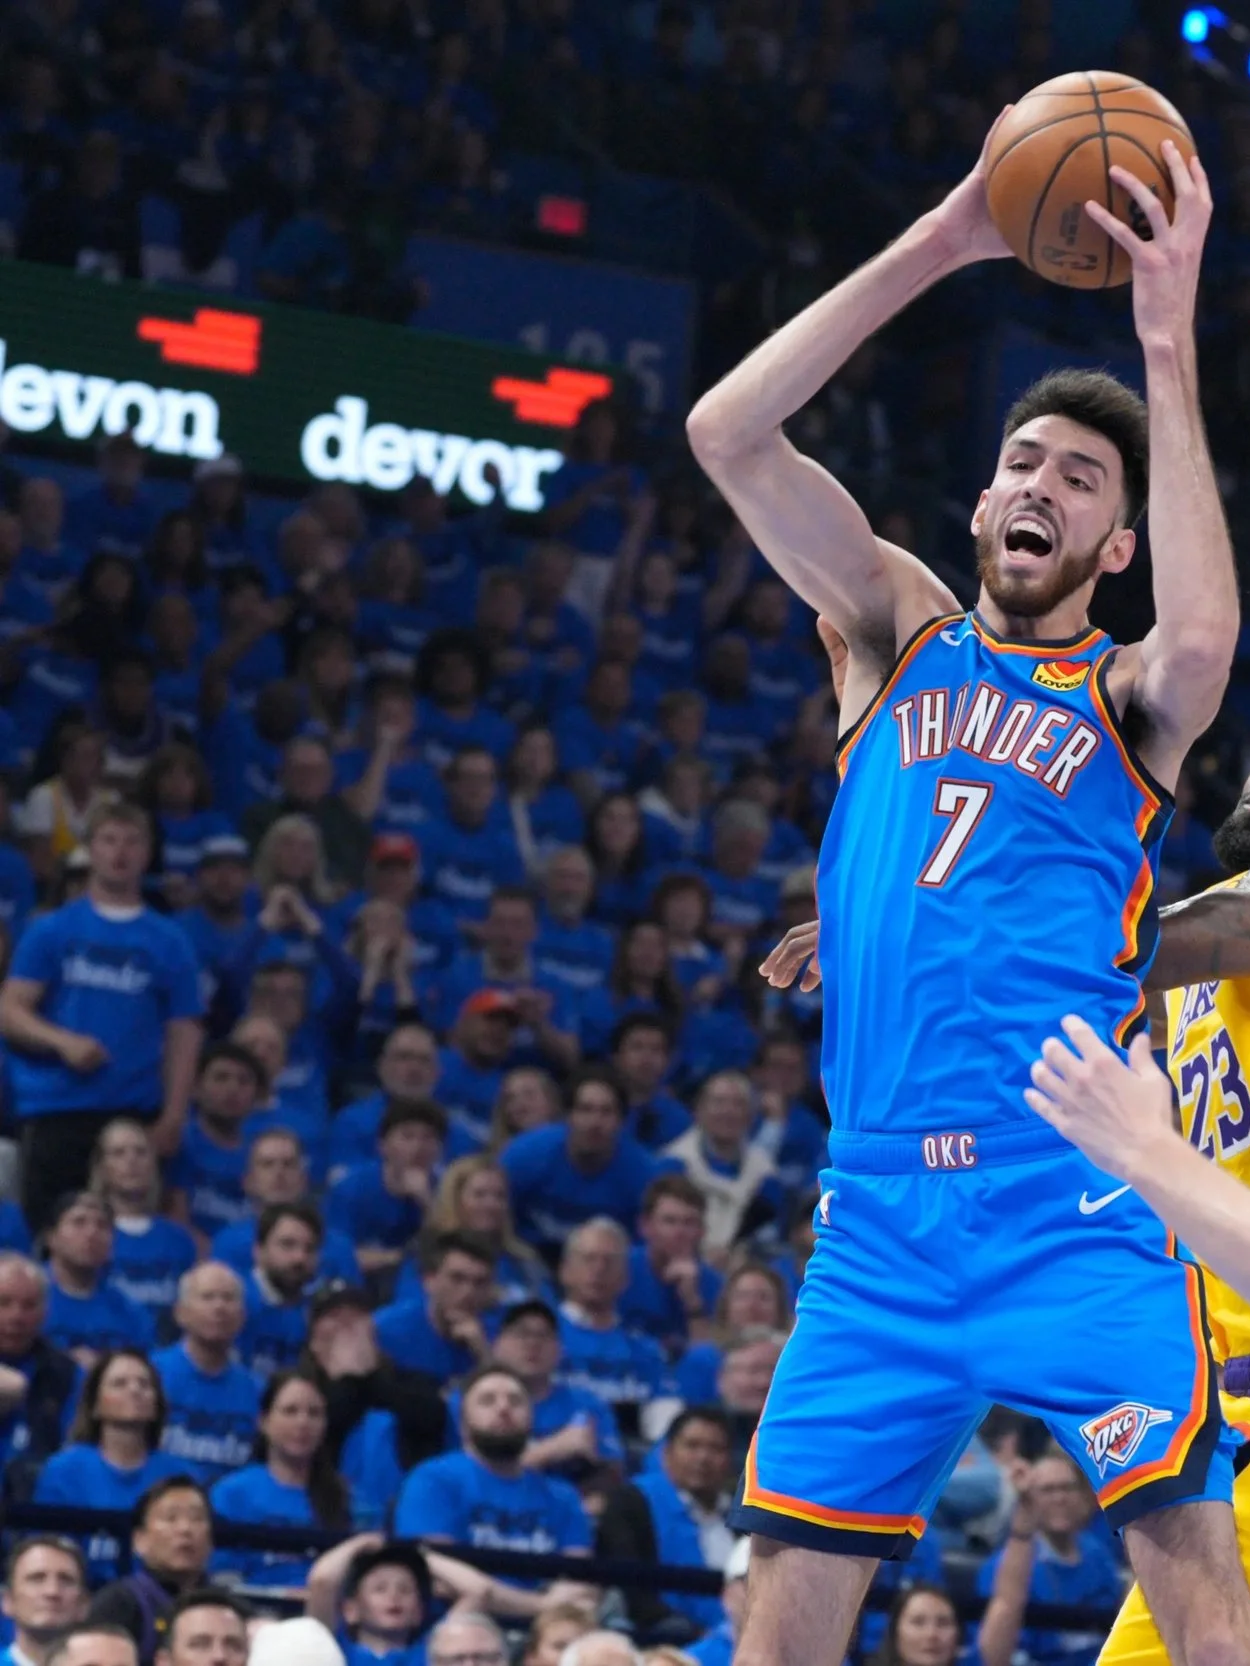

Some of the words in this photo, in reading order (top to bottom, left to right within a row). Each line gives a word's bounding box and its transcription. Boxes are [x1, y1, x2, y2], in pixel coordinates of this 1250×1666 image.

[0, 338, 223, 460] evon
[892, 680, 1104, 801] THUNDER
[914, 777, 995, 888] 7
[921, 1131, 979, 1170] OKC
[1092, 1411, 1134, 1464] OKC
